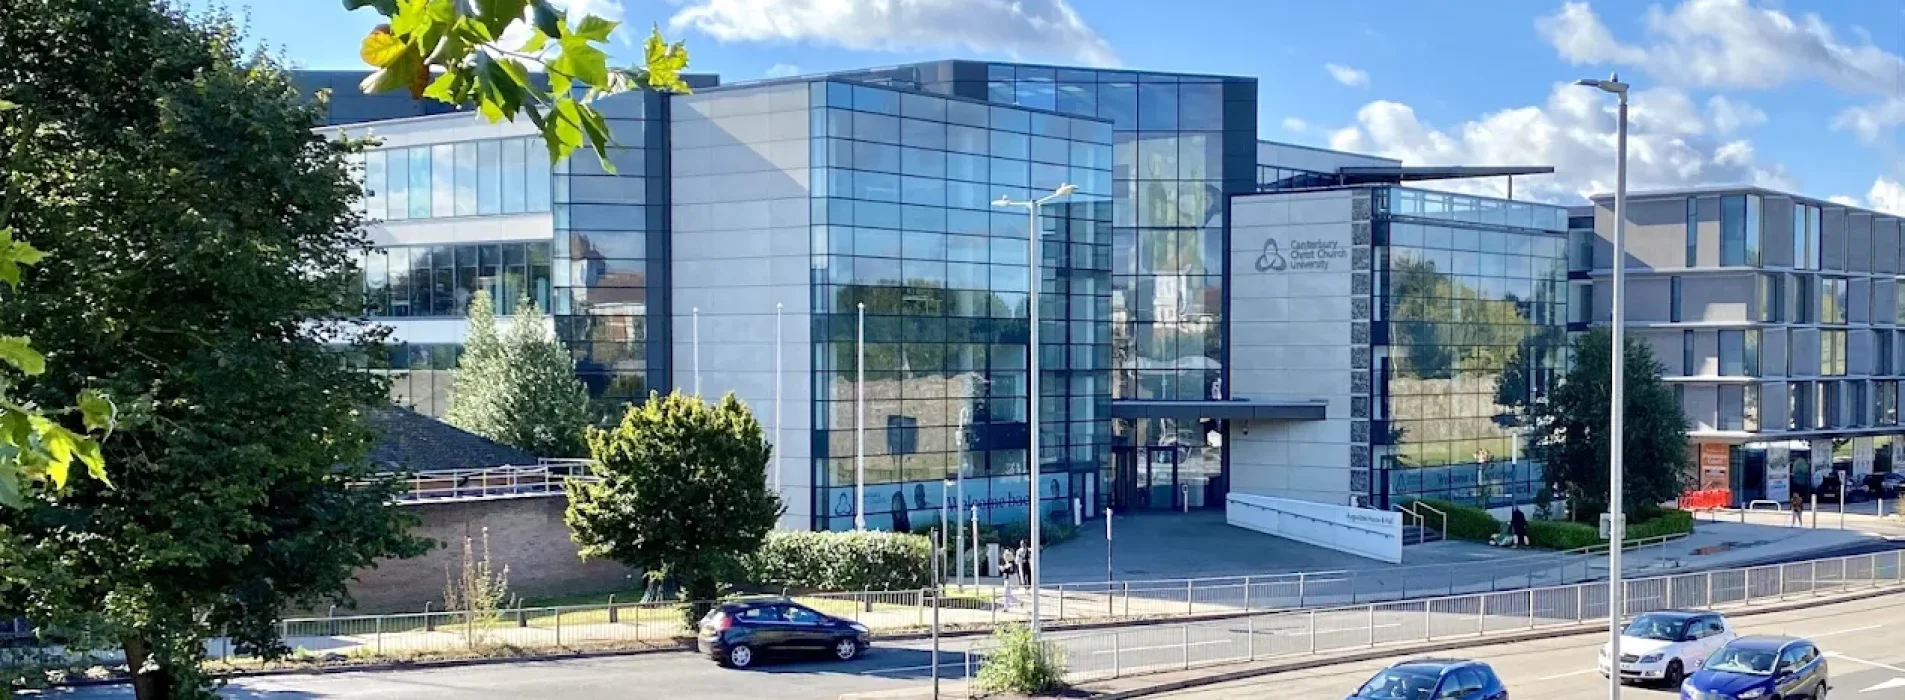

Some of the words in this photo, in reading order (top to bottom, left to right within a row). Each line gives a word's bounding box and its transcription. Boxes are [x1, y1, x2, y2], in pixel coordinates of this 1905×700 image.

[1290, 239, 1338, 250] Canterbury
[1290, 250, 1315, 259] Christ
[1317, 249, 1347, 259] Church
[1290, 260, 1329, 270] University
[1007, 492, 1031, 507] bac
